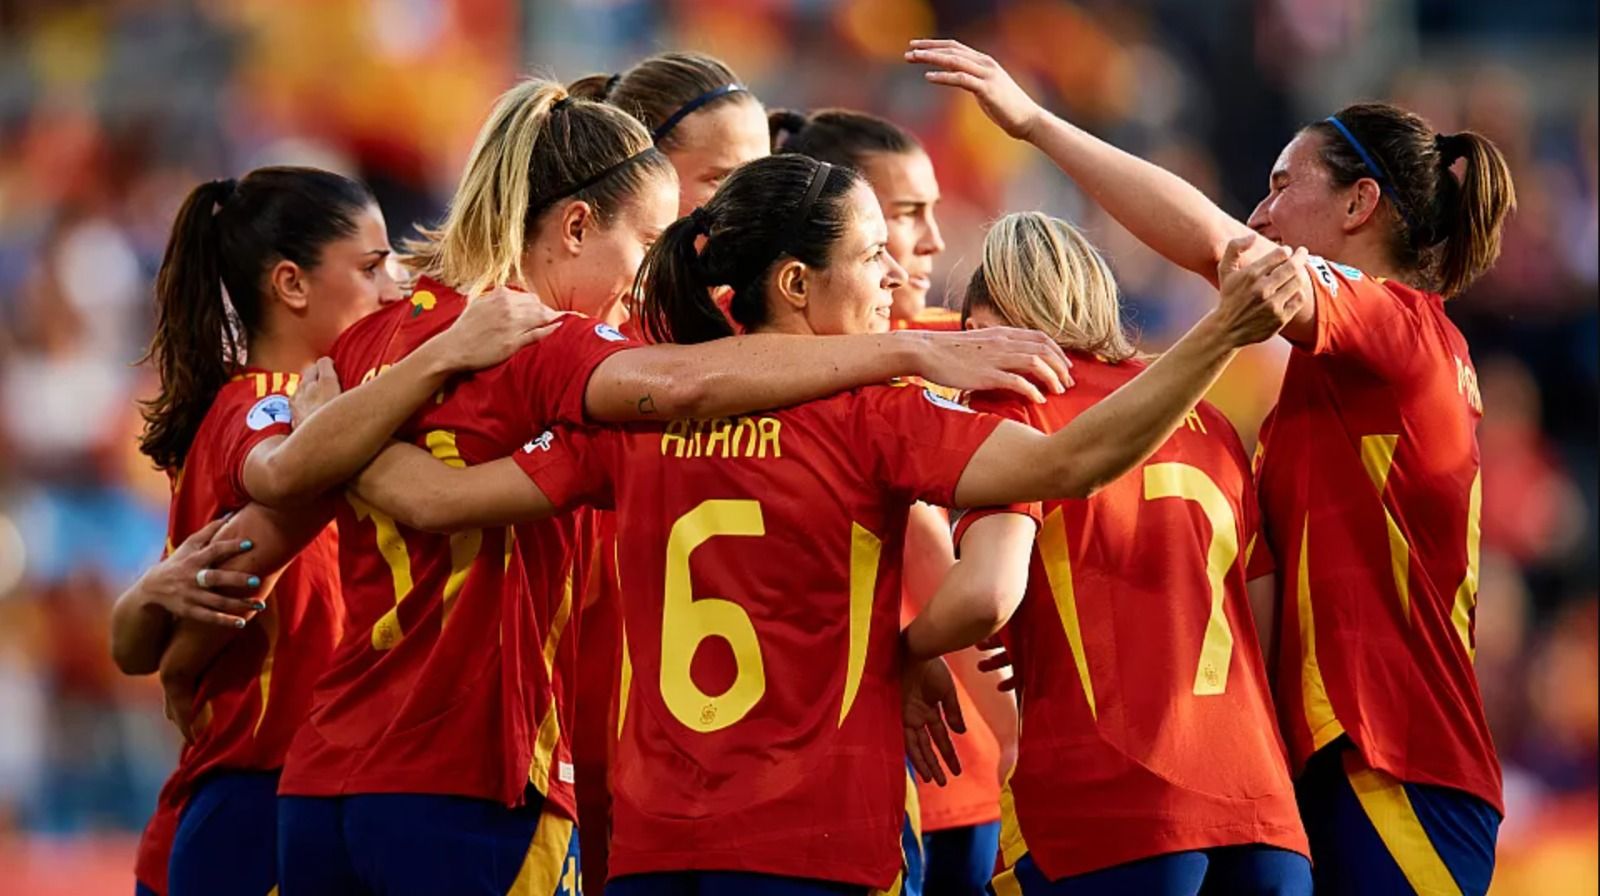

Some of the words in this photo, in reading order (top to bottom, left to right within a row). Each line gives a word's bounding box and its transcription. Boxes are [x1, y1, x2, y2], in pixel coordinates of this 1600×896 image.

[660, 416, 782, 459] AITANA
[659, 499, 766, 733] 6
[1143, 462, 1239, 696] 7
